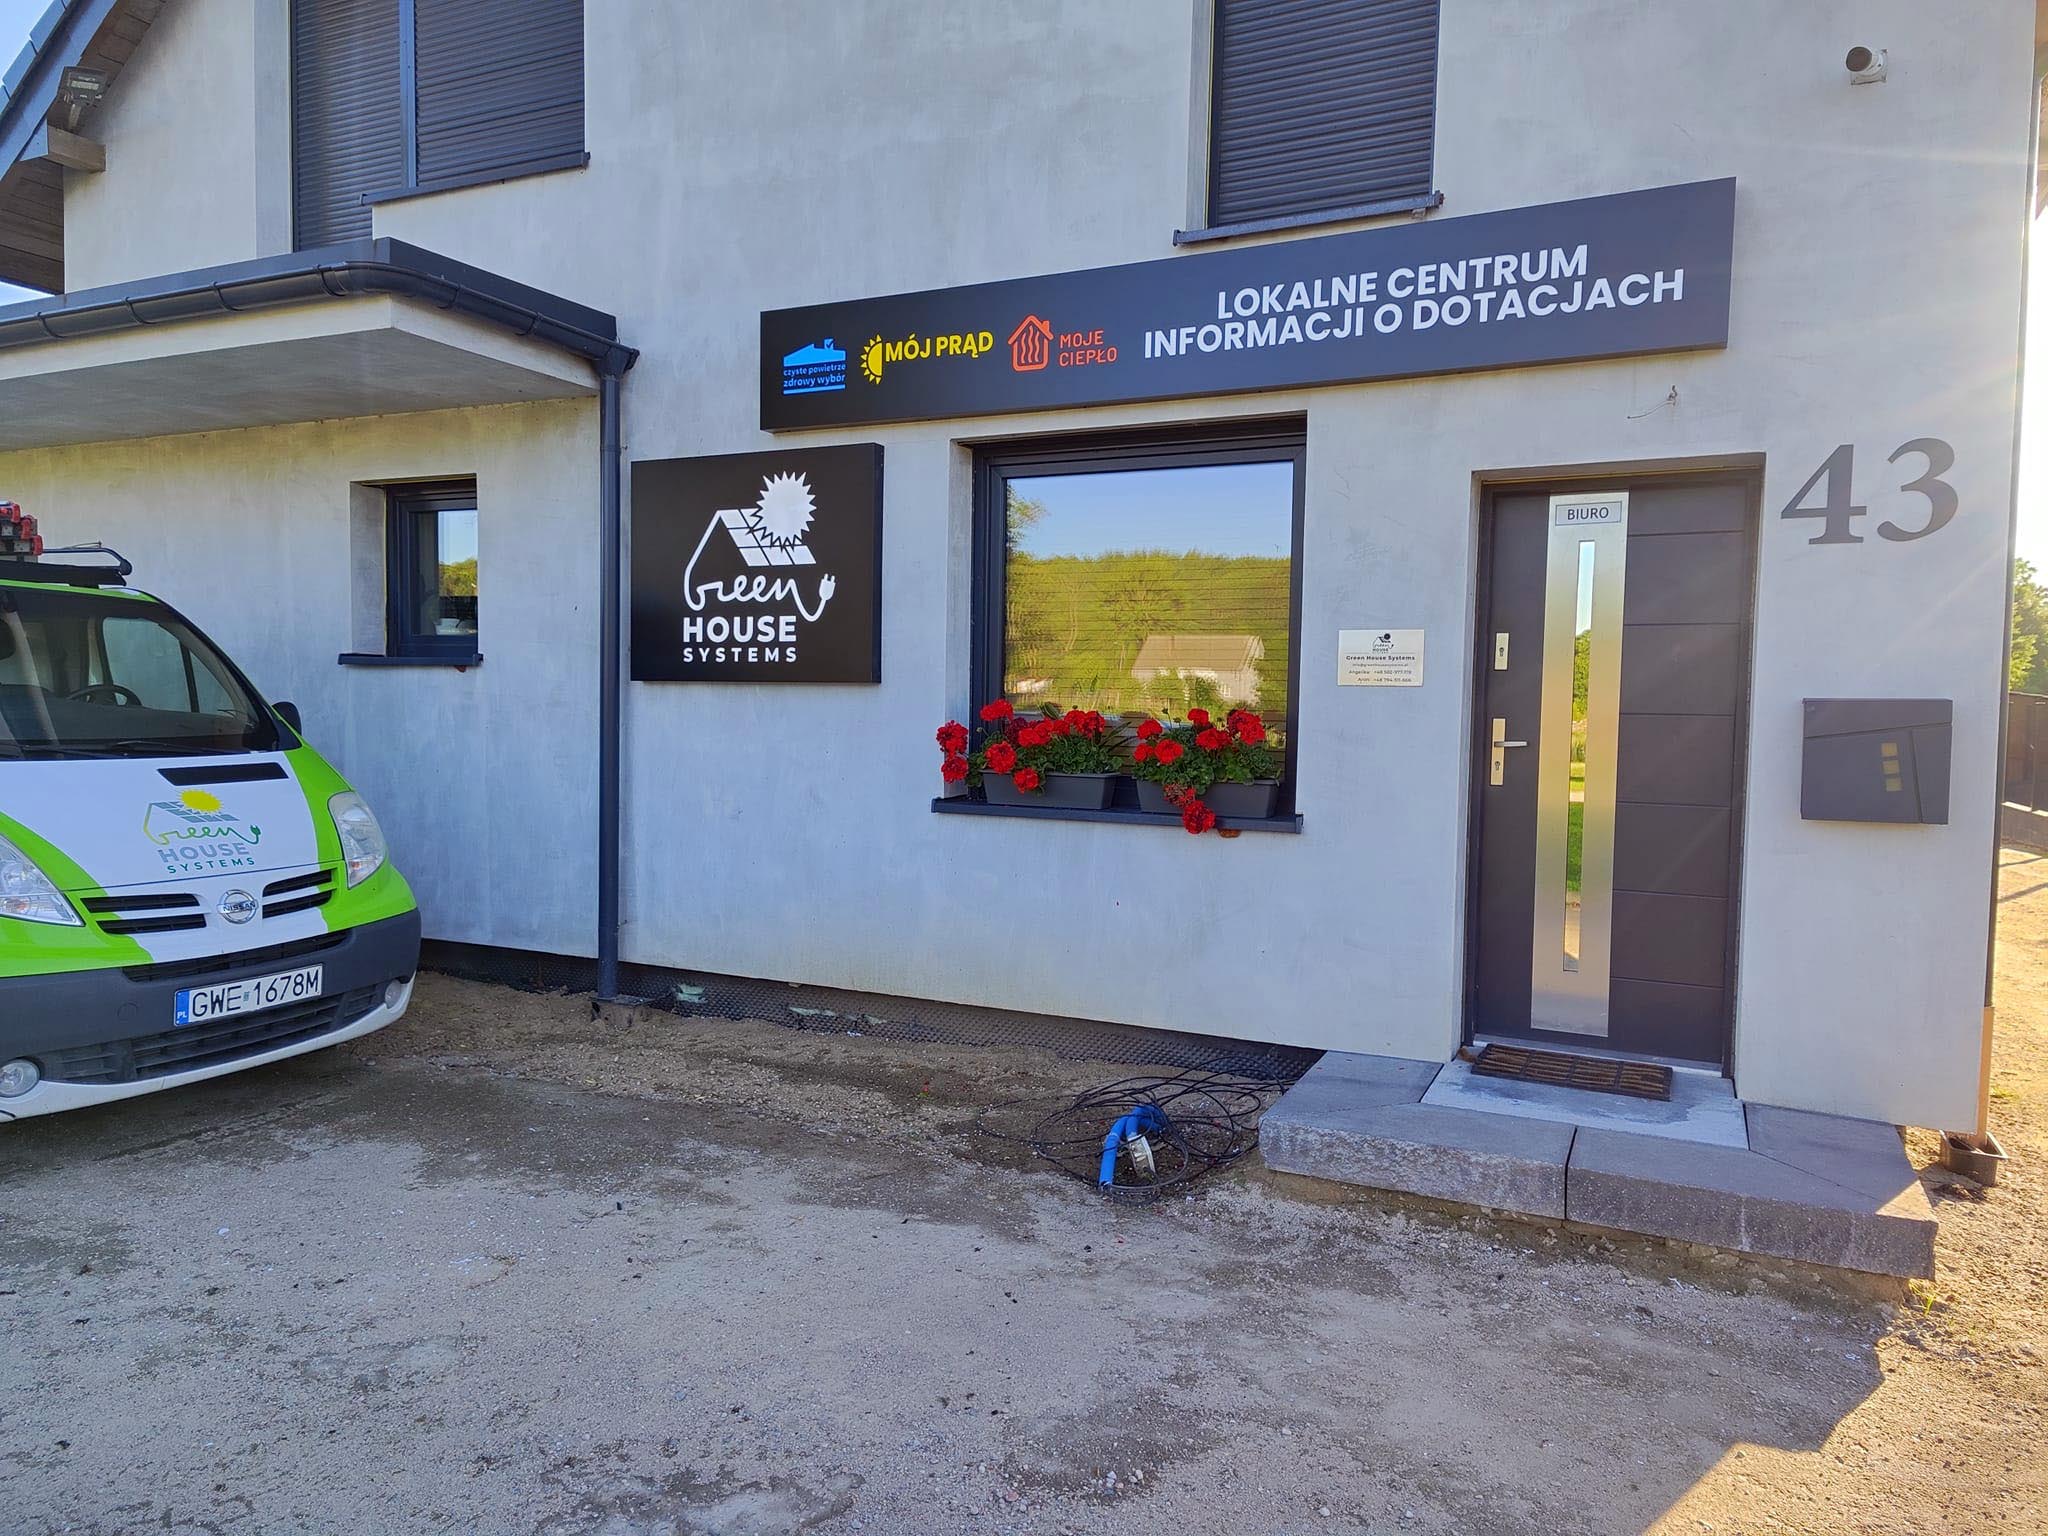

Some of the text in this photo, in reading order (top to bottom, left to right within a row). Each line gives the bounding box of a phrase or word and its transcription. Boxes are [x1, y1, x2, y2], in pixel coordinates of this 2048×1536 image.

[1217, 244, 1588, 320] LOKALNE CENTRUM
[1144, 268, 1684, 359] INFORMACJI O DOTACJACH
[885, 331, 994, 362] MÓJ PRĄD
[1059, 330, 1104, 350] MOJE
[1058, 347, 1117, 367] CIEPŁO
[783, 363, 846, 377] czyste powietrze
[783, 373, 846, 387] zdrowy wybór
[1780, 437, 1959, 544] 43
[1566, 506, 1610, 521] BIURO
[684, 565, 812, 614] Green
[683, 615, 797, 643] HOUSE
[683, 647, 797, 663] SYSTEMS
[143, 825, 240, 846] Green
[158, 842, 249, 863] HOUSE
[167, 857, 255, 874] SYSTEMS
[222, 899, 256, 912] NISSAN
[176, 969, 320, 1019] PL GWE 1678M
